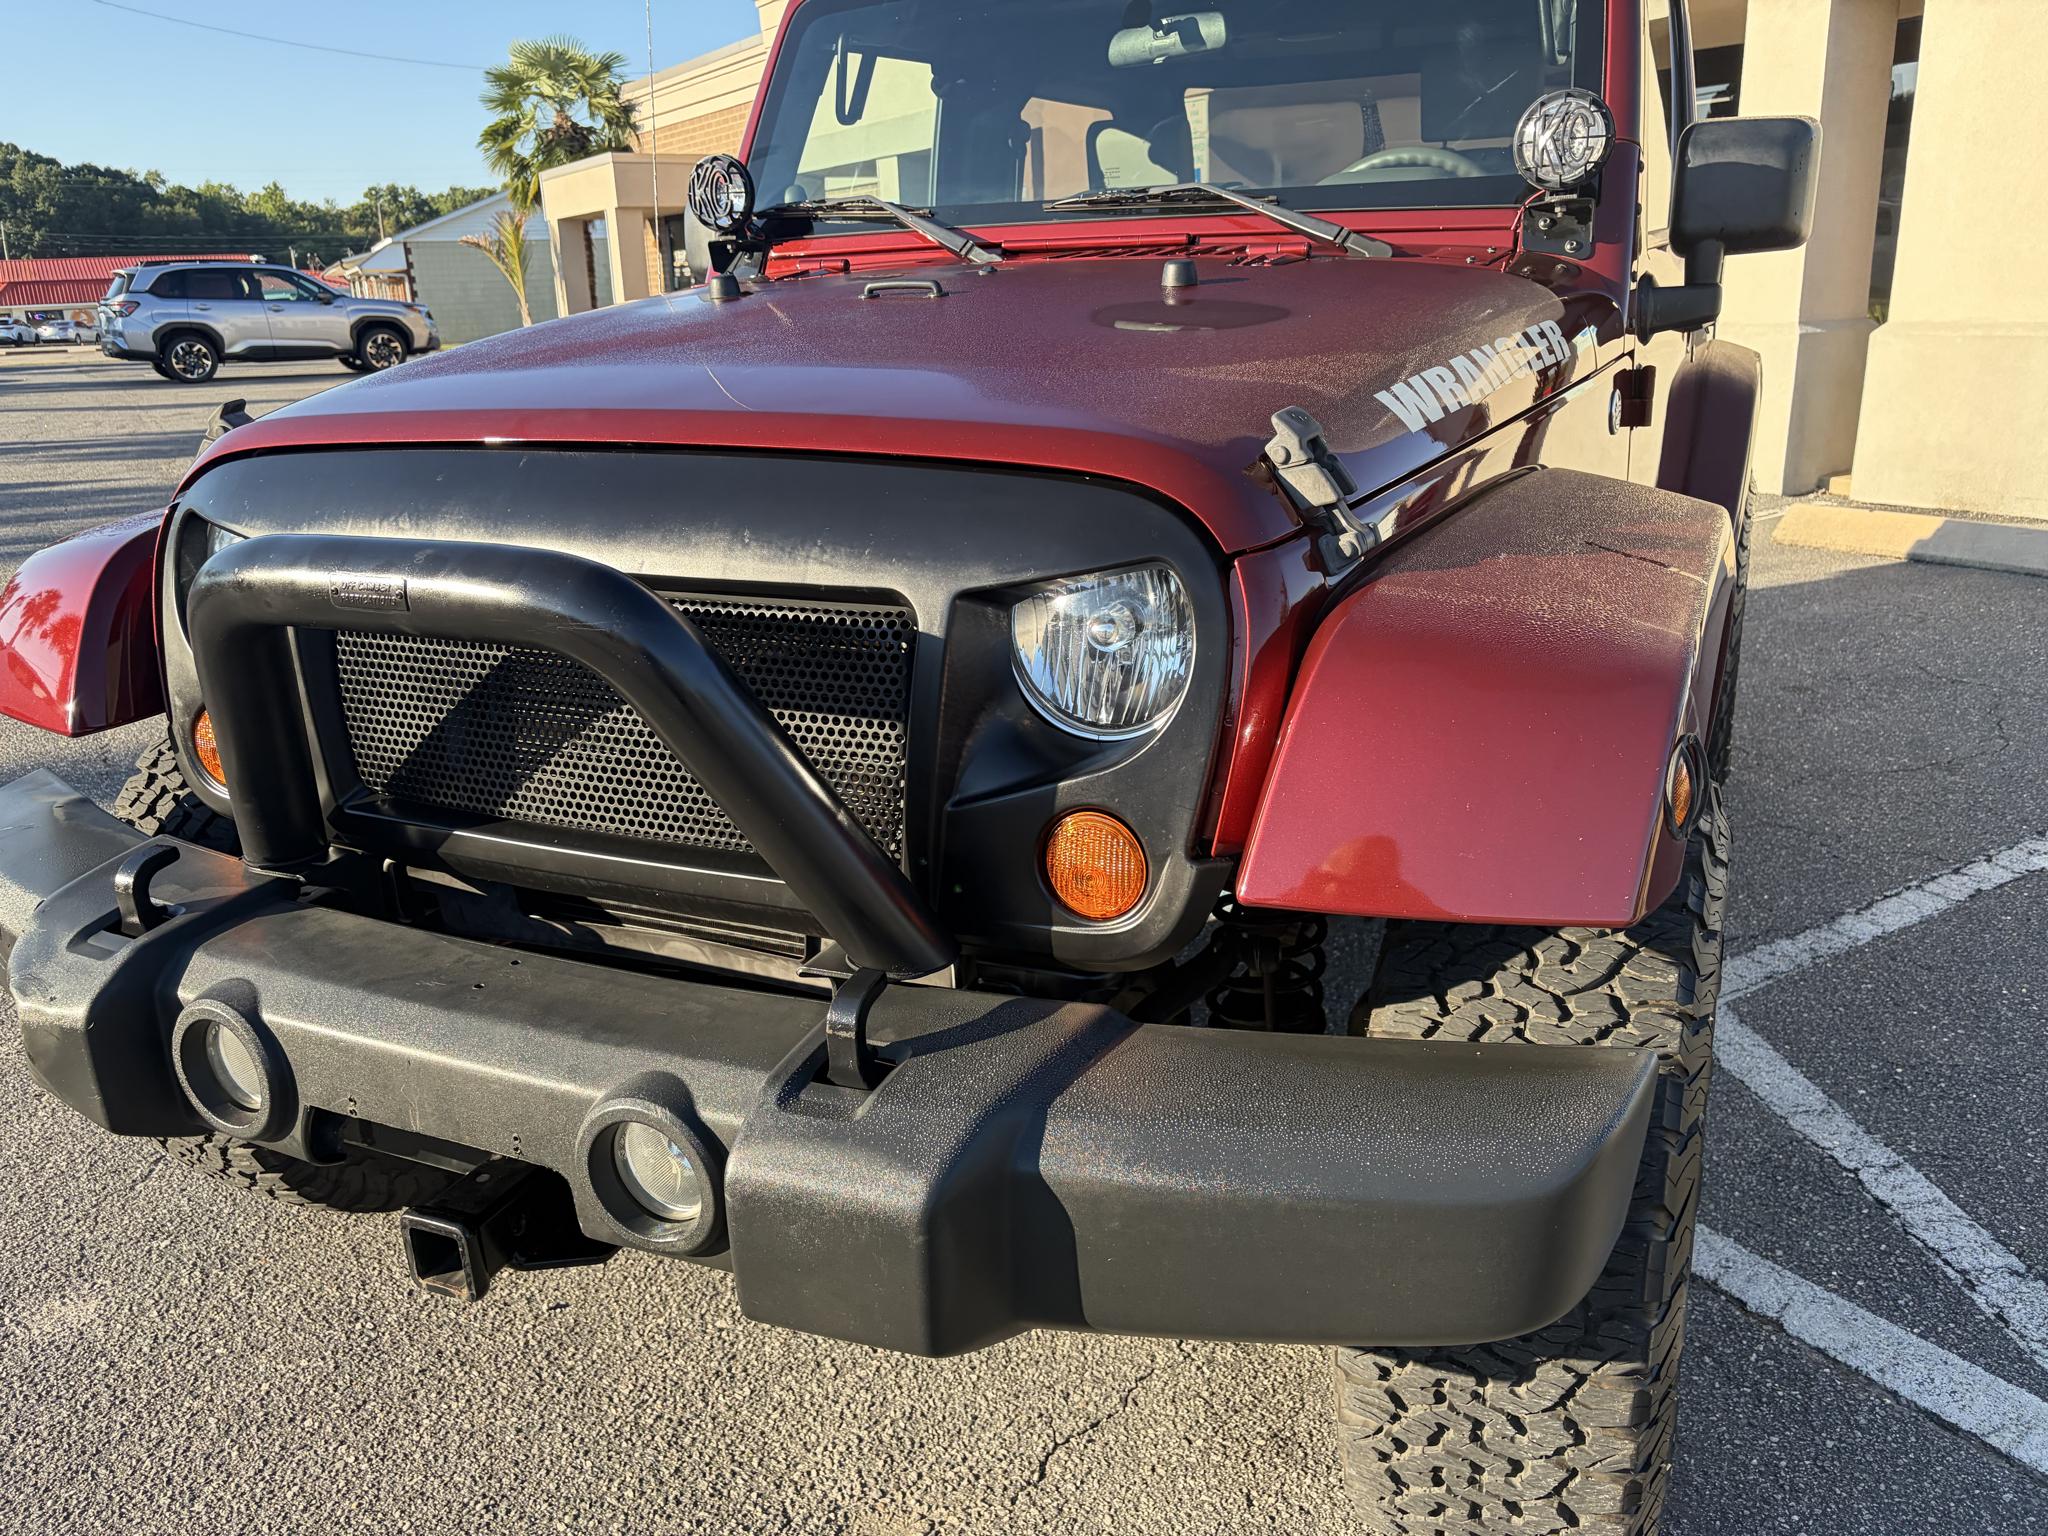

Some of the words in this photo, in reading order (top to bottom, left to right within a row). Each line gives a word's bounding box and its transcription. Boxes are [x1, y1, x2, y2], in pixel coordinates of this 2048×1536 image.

[1532, 101, 1595, 175] KC
[689, 165, 732, 221] KC
[1373, 319, 1571, 433] WRANGLER
